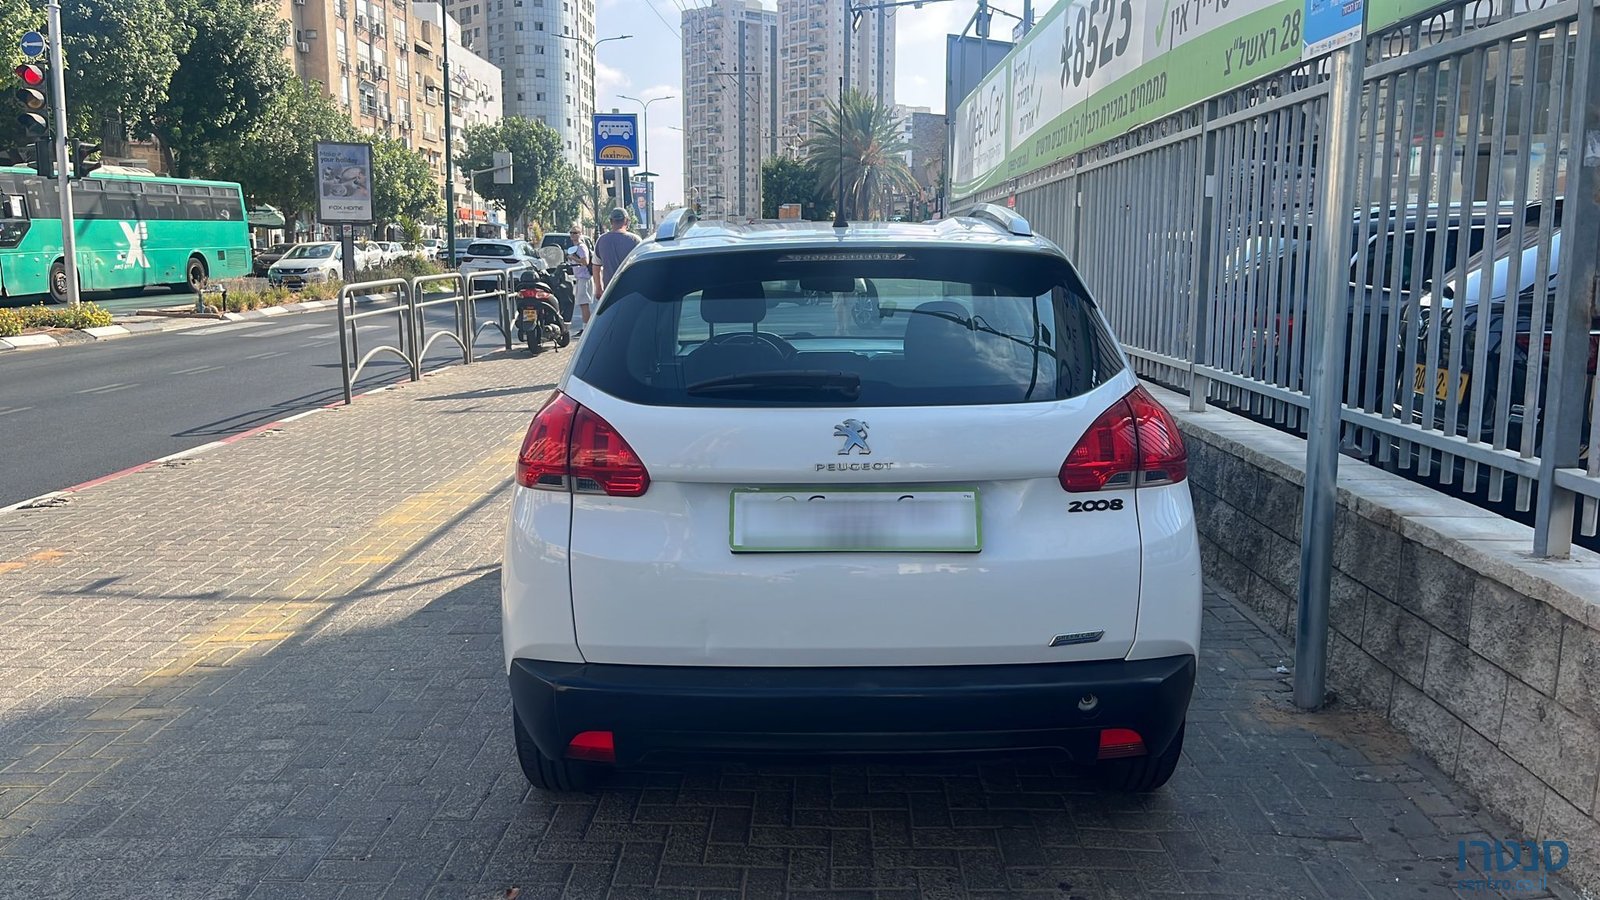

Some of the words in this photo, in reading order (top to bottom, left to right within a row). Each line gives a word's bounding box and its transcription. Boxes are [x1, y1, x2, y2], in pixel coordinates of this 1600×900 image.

[1280, 8, 1301, 52] 28
[1099, 92, 1129, 129] במכירת
[1130, 71, 1168, 113] מתמחים
[814, 462, 894, 472] PEUGEOT
[1068, 498, 1124, 513] 2008
